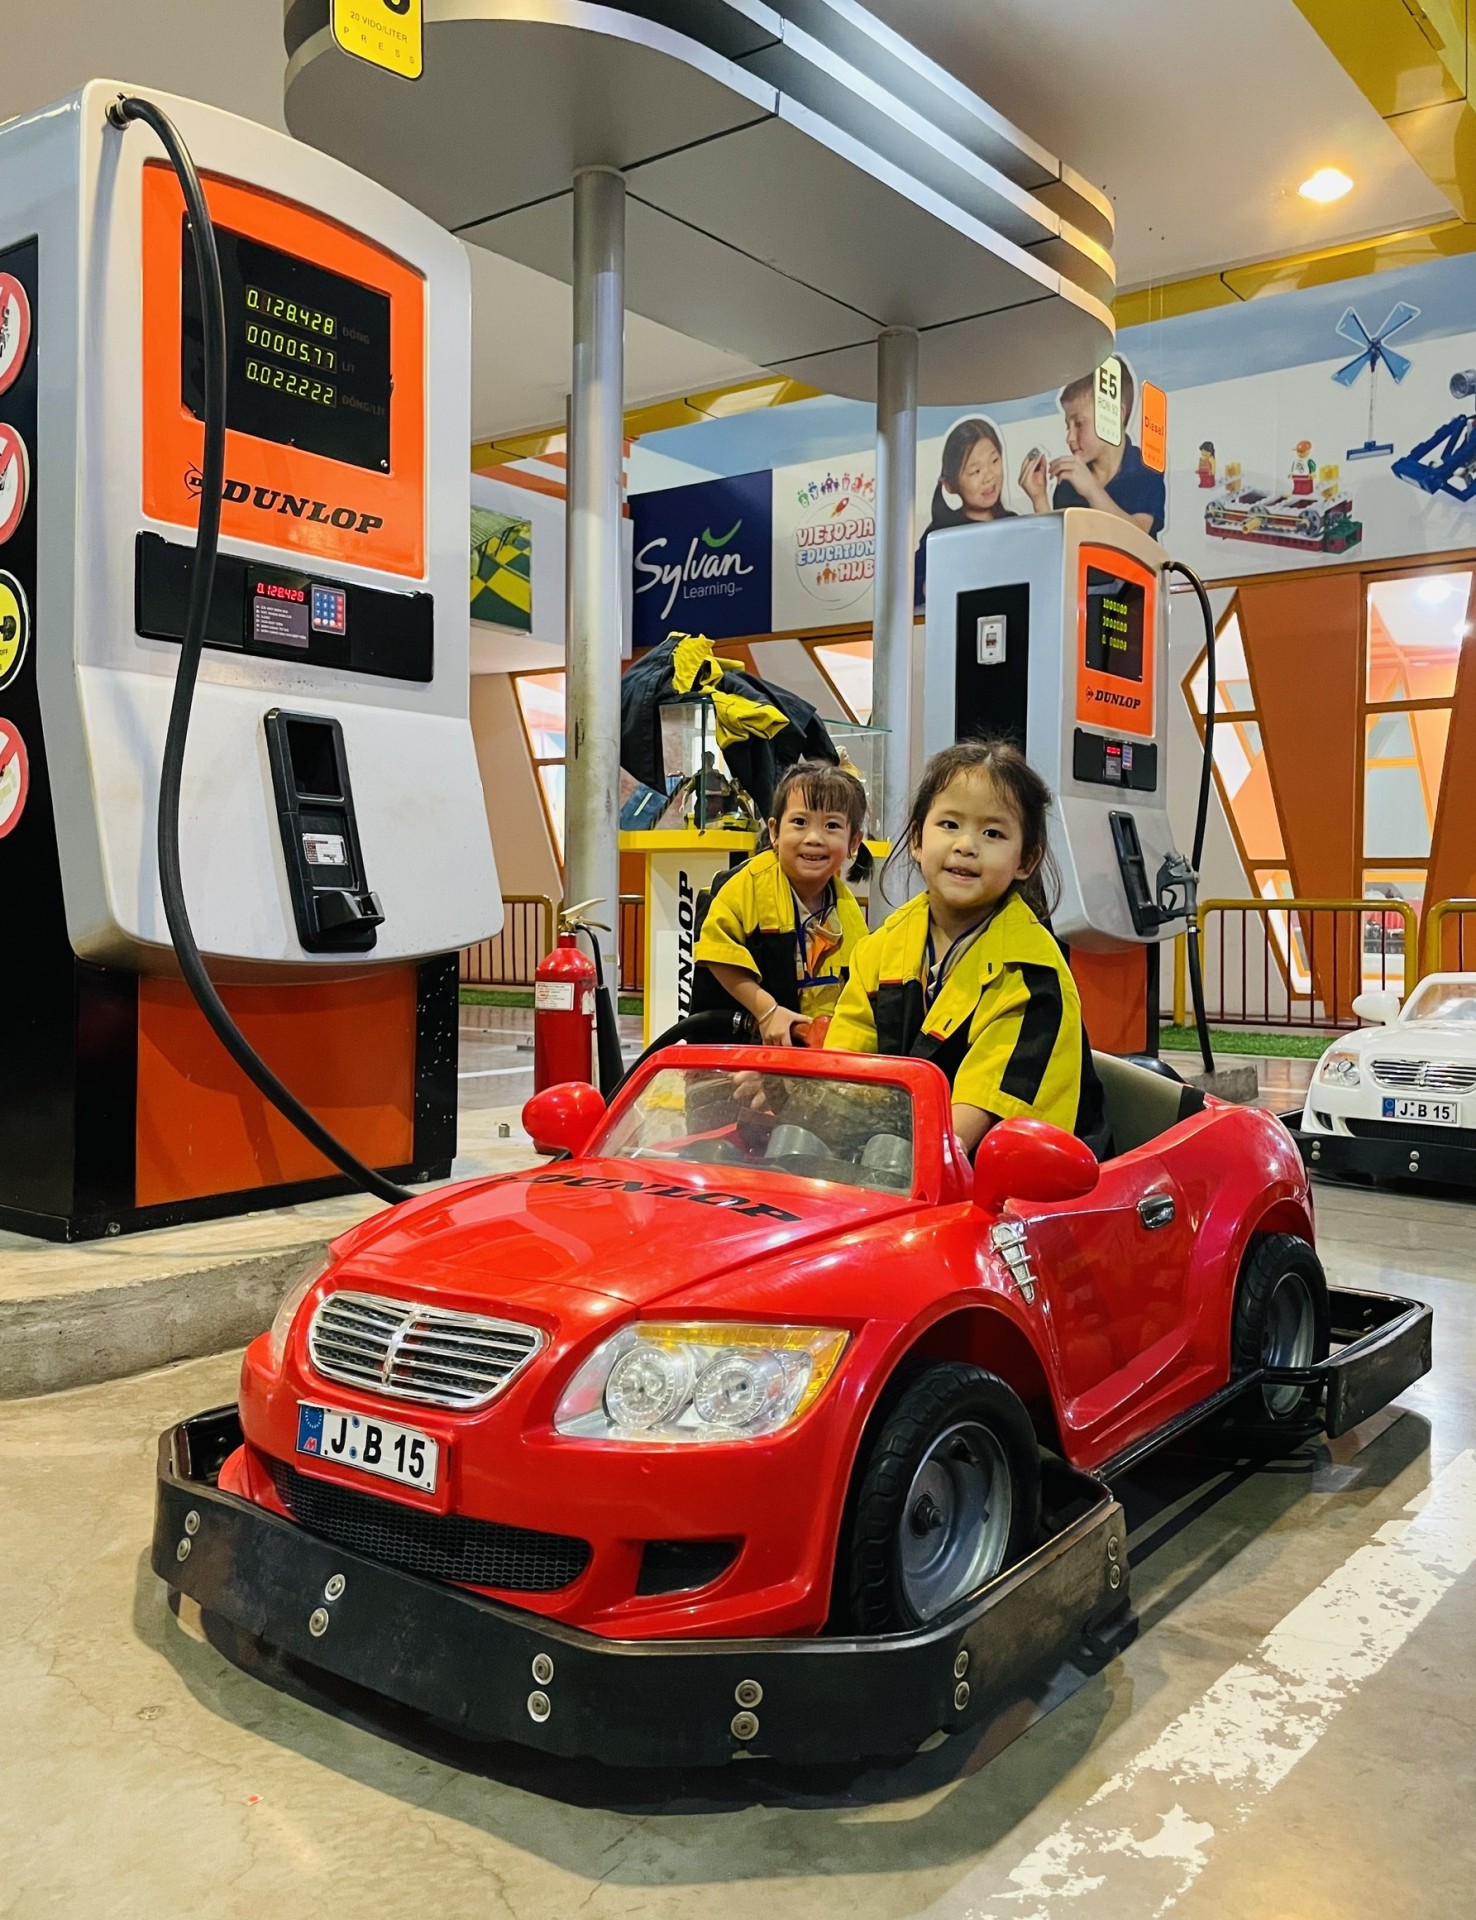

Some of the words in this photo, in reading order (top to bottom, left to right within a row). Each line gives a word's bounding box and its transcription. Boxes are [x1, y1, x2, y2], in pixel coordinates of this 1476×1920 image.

[247, 289, 334, 335] 0.128.428
[247, 325, 334, 369] 00005.77
[247, 362, 334, 405] 0.022.222
[1099, 367, 1117, 400] E5
[221, 479, 384, 534] DUNLOP
[796, 517, 875, 548] VIETOPIA
[796, 539, 875, 567] EDUCATION
[635, 537, 754, 620] Sylvan
[683, 580, 736, 600] Learning
[838, 558, 875, 583] HUB
[1095, 689, 1141, 709] DUNLOP
[678, 870, 693, 1024] UNLOP
[1400, 1103, 1408, 1116] J
[1418, 1104, 1427, 1118] B
[1433, 1105, 1450, 1120] 15
[533, 1173, 802, 1222] DUNLOP
[331, 1417, 347, 1454] J
[363, 1424, 382, 1464] B
[394, 1433, 426, 1478] 15
